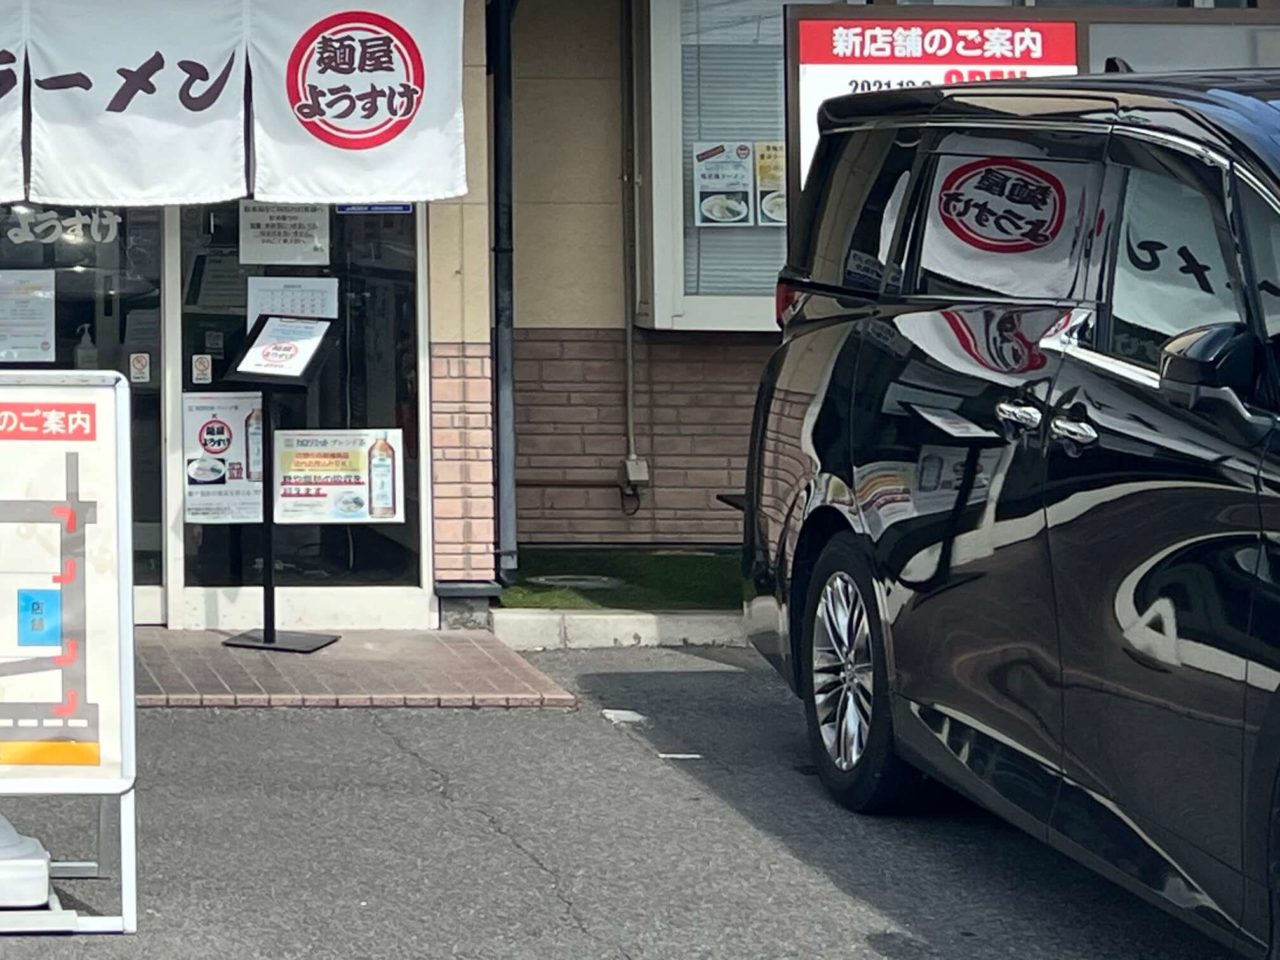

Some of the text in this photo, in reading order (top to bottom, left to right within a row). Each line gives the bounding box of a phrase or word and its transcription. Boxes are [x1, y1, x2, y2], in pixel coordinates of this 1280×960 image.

[317, 35, 395, 74] 麺屋
[832, 27, 1043, 58] 新店舗のご案内
[298, 78, 421, 121] ようすけ
